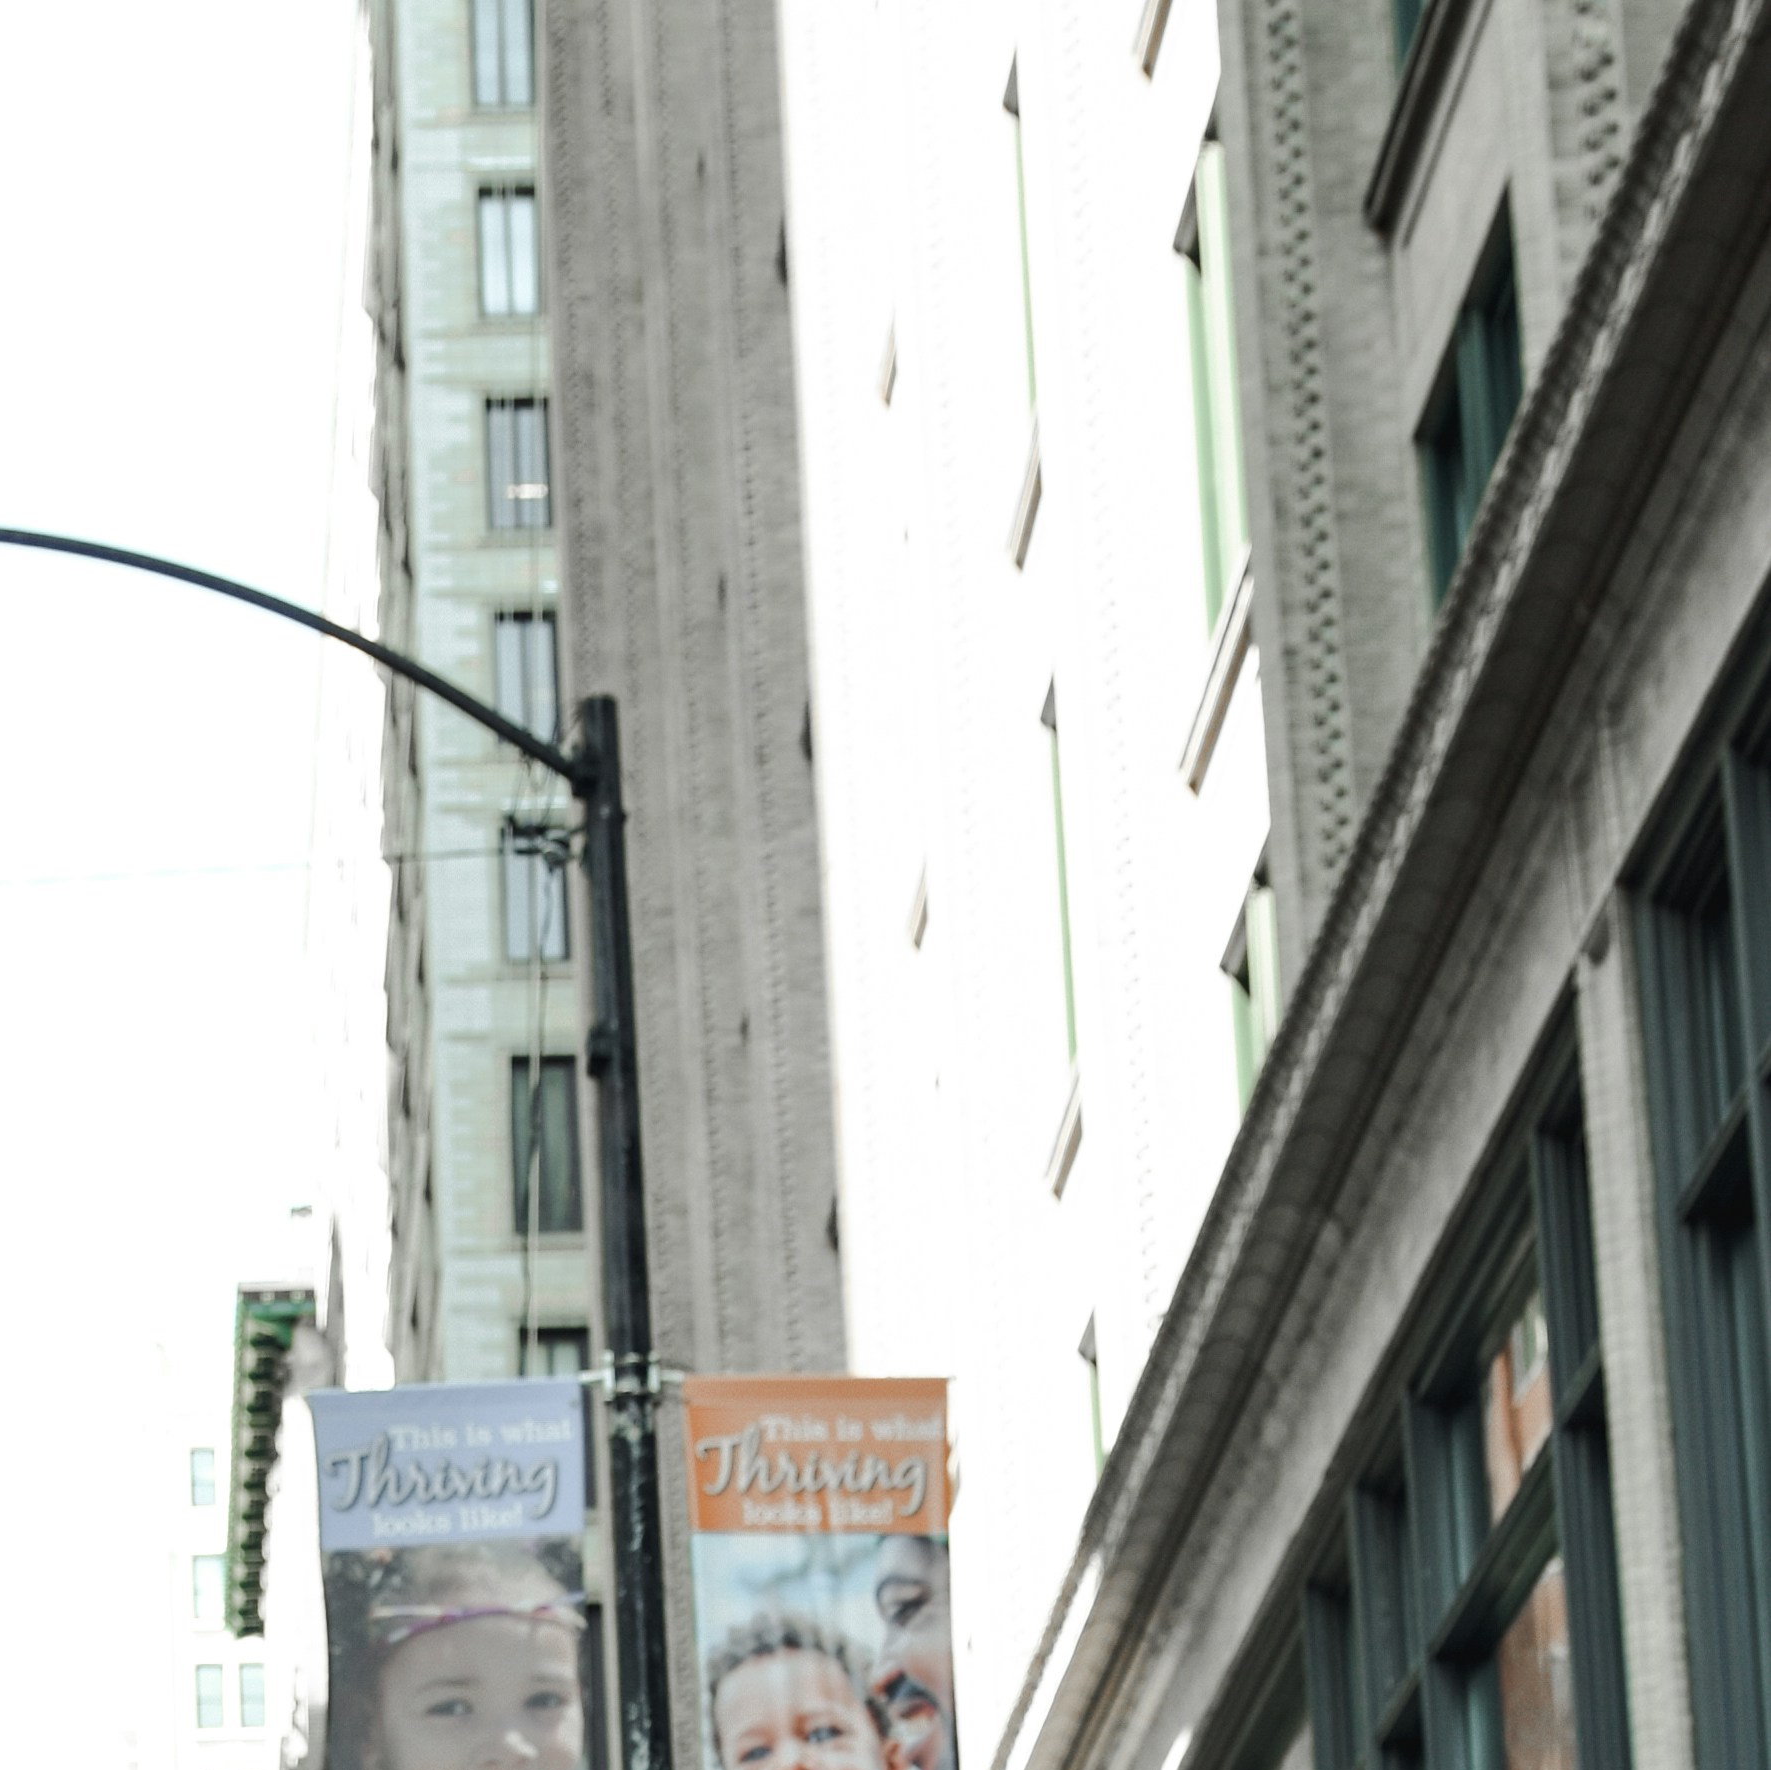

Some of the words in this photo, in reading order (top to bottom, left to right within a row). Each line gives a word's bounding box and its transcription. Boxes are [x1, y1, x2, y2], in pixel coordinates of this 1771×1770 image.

[388, 1422, 457, 1450] This
[466, 1421, 493, 1447] is
[499, 1417, 571, 1443] what
[761, 1412, 828, 1442] This
[835, 1411, 863, 1441] is
[869, 1408, 943, 1441] what
[324, 1429, 559, 1521] Thriving
[695, 1422, 927, 1518] Thriving
[372, 1507, 452, 1538] looks
[459, 1502, 524, 1533] like!
[742, 1499, 823, 1526] looks
